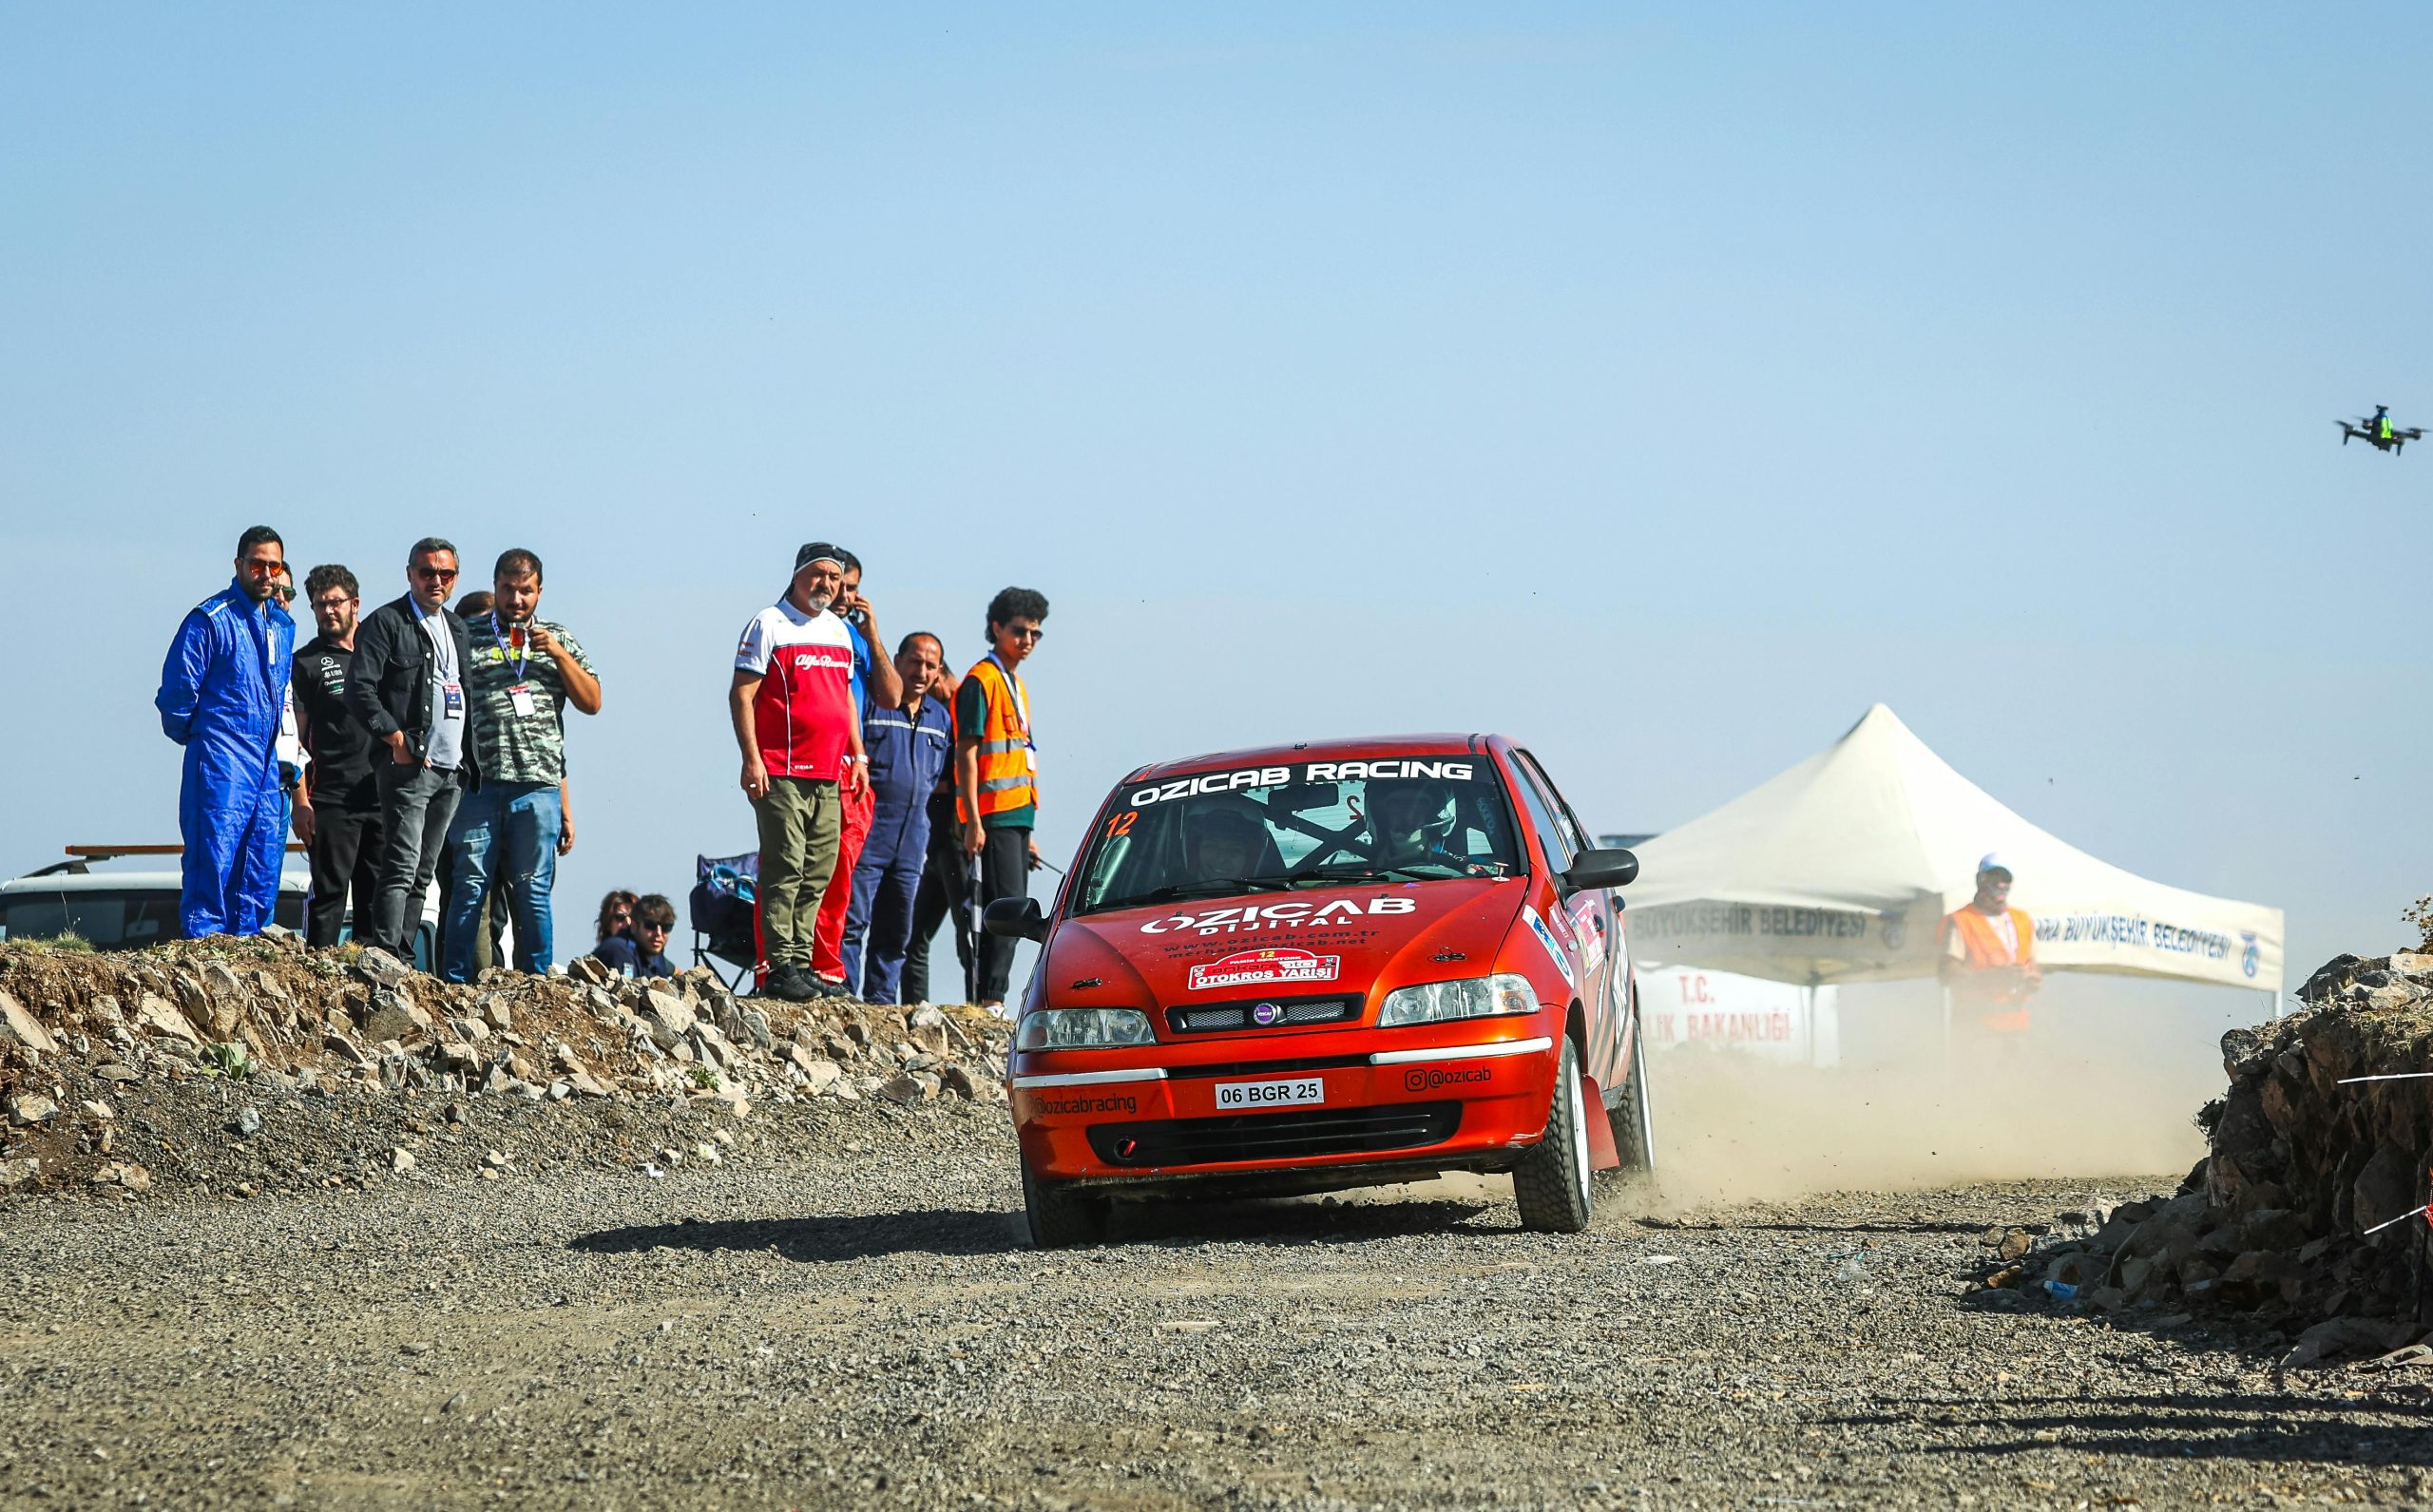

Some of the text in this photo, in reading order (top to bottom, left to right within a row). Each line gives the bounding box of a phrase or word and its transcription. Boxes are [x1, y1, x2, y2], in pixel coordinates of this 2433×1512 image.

[795, 654, 820, 670] Alfa
[1130, 760, 1473, 808] OZICAB RACING
[1106, 811, 1139, 837] 12
[1140, 897, 1416, 934] OZICAB
[1760, 907, 1866, 938] BELEDİYESİ
[1164, 930, 1379, 952] www.ozicab.com.tr
[1168, 939, 1367, 959] merhaba@ozicab.net
[1196, 967, 1331, 986] OTOKROS YARIŞI
[1687, 1005, 1791, 1042] BAKANLIĞI
[1428, 1065, 1491, 1088] @ozicab
[1221, 1083, 1318, 1103] 06 BGR 25
